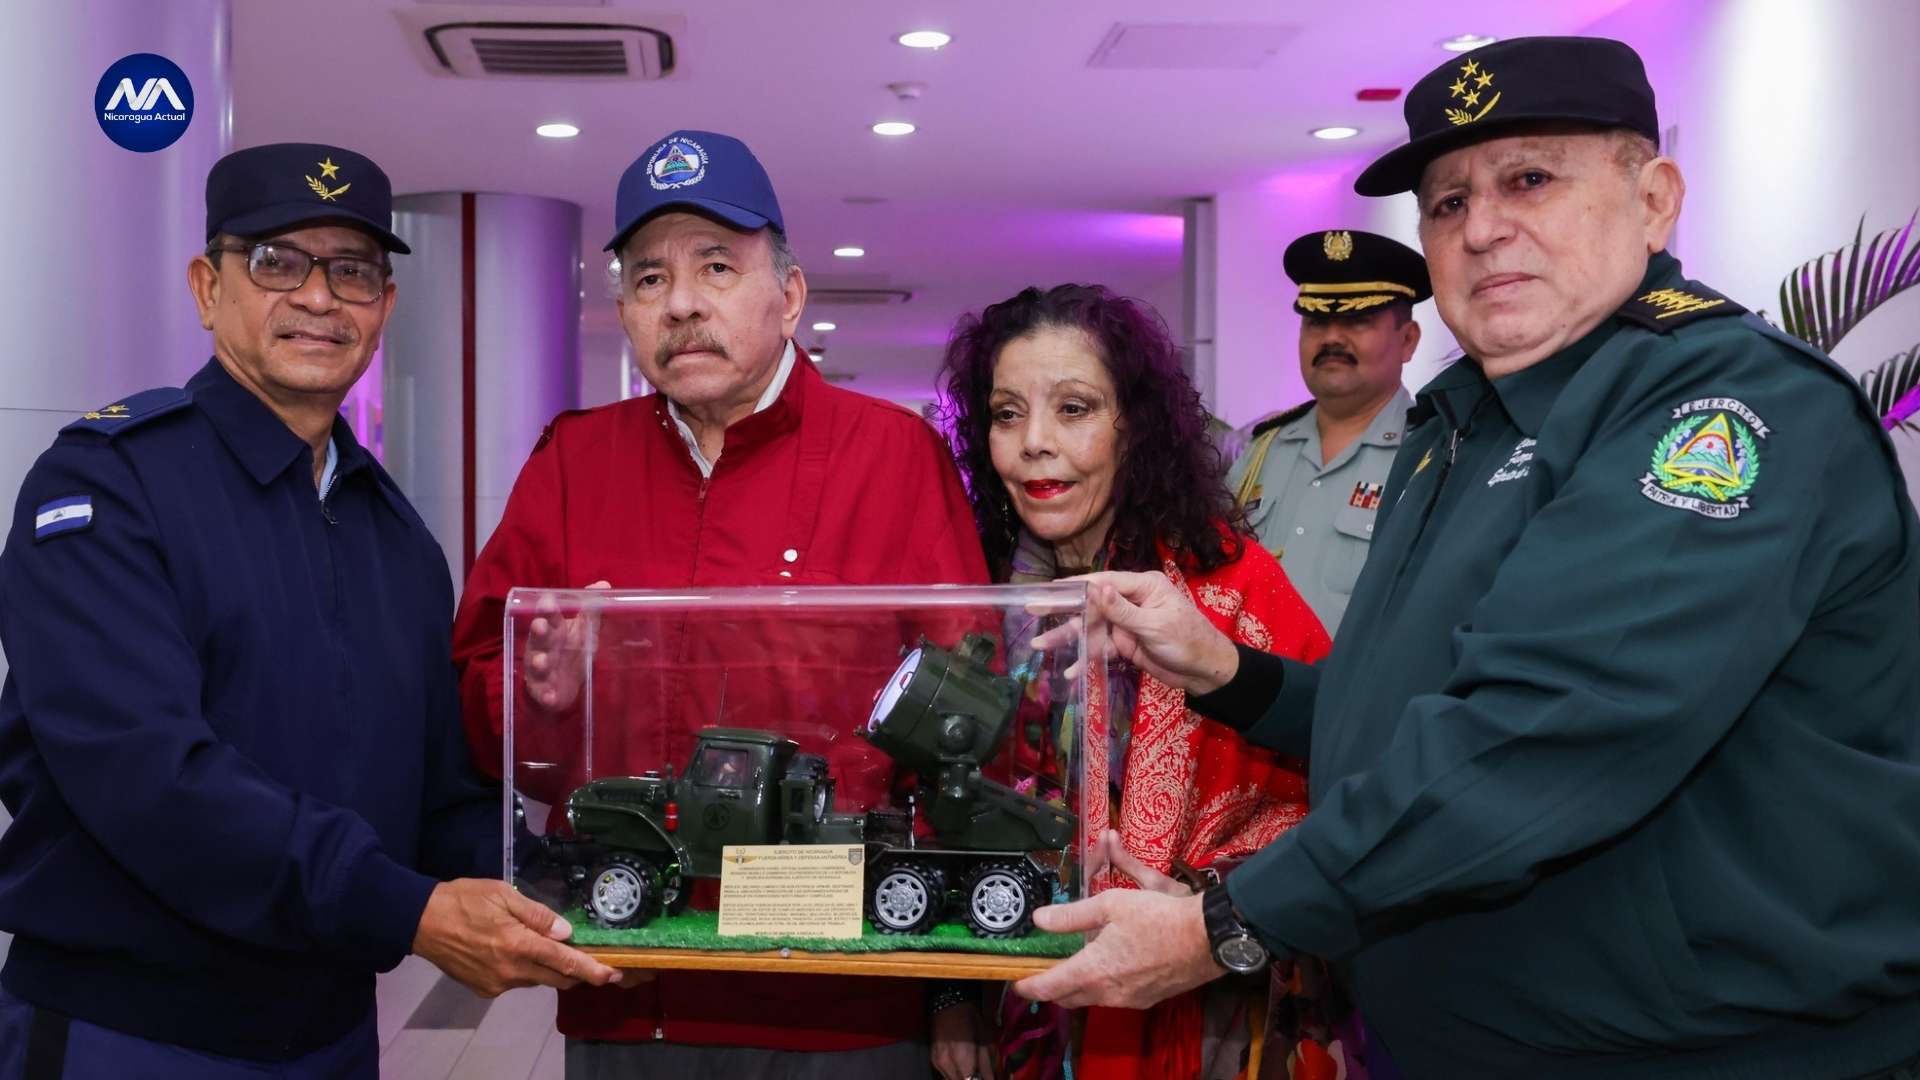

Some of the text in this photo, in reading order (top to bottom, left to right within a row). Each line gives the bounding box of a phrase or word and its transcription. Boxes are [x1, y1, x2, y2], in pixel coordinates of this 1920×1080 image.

[680, 136, 709, 165] NICARAGUA
[1689, 399, 1758, 424] EJERCITO
[1646, 486, 1676, 505] PATRIA
[1691, 500, 1738, 515] LIBERTAD
